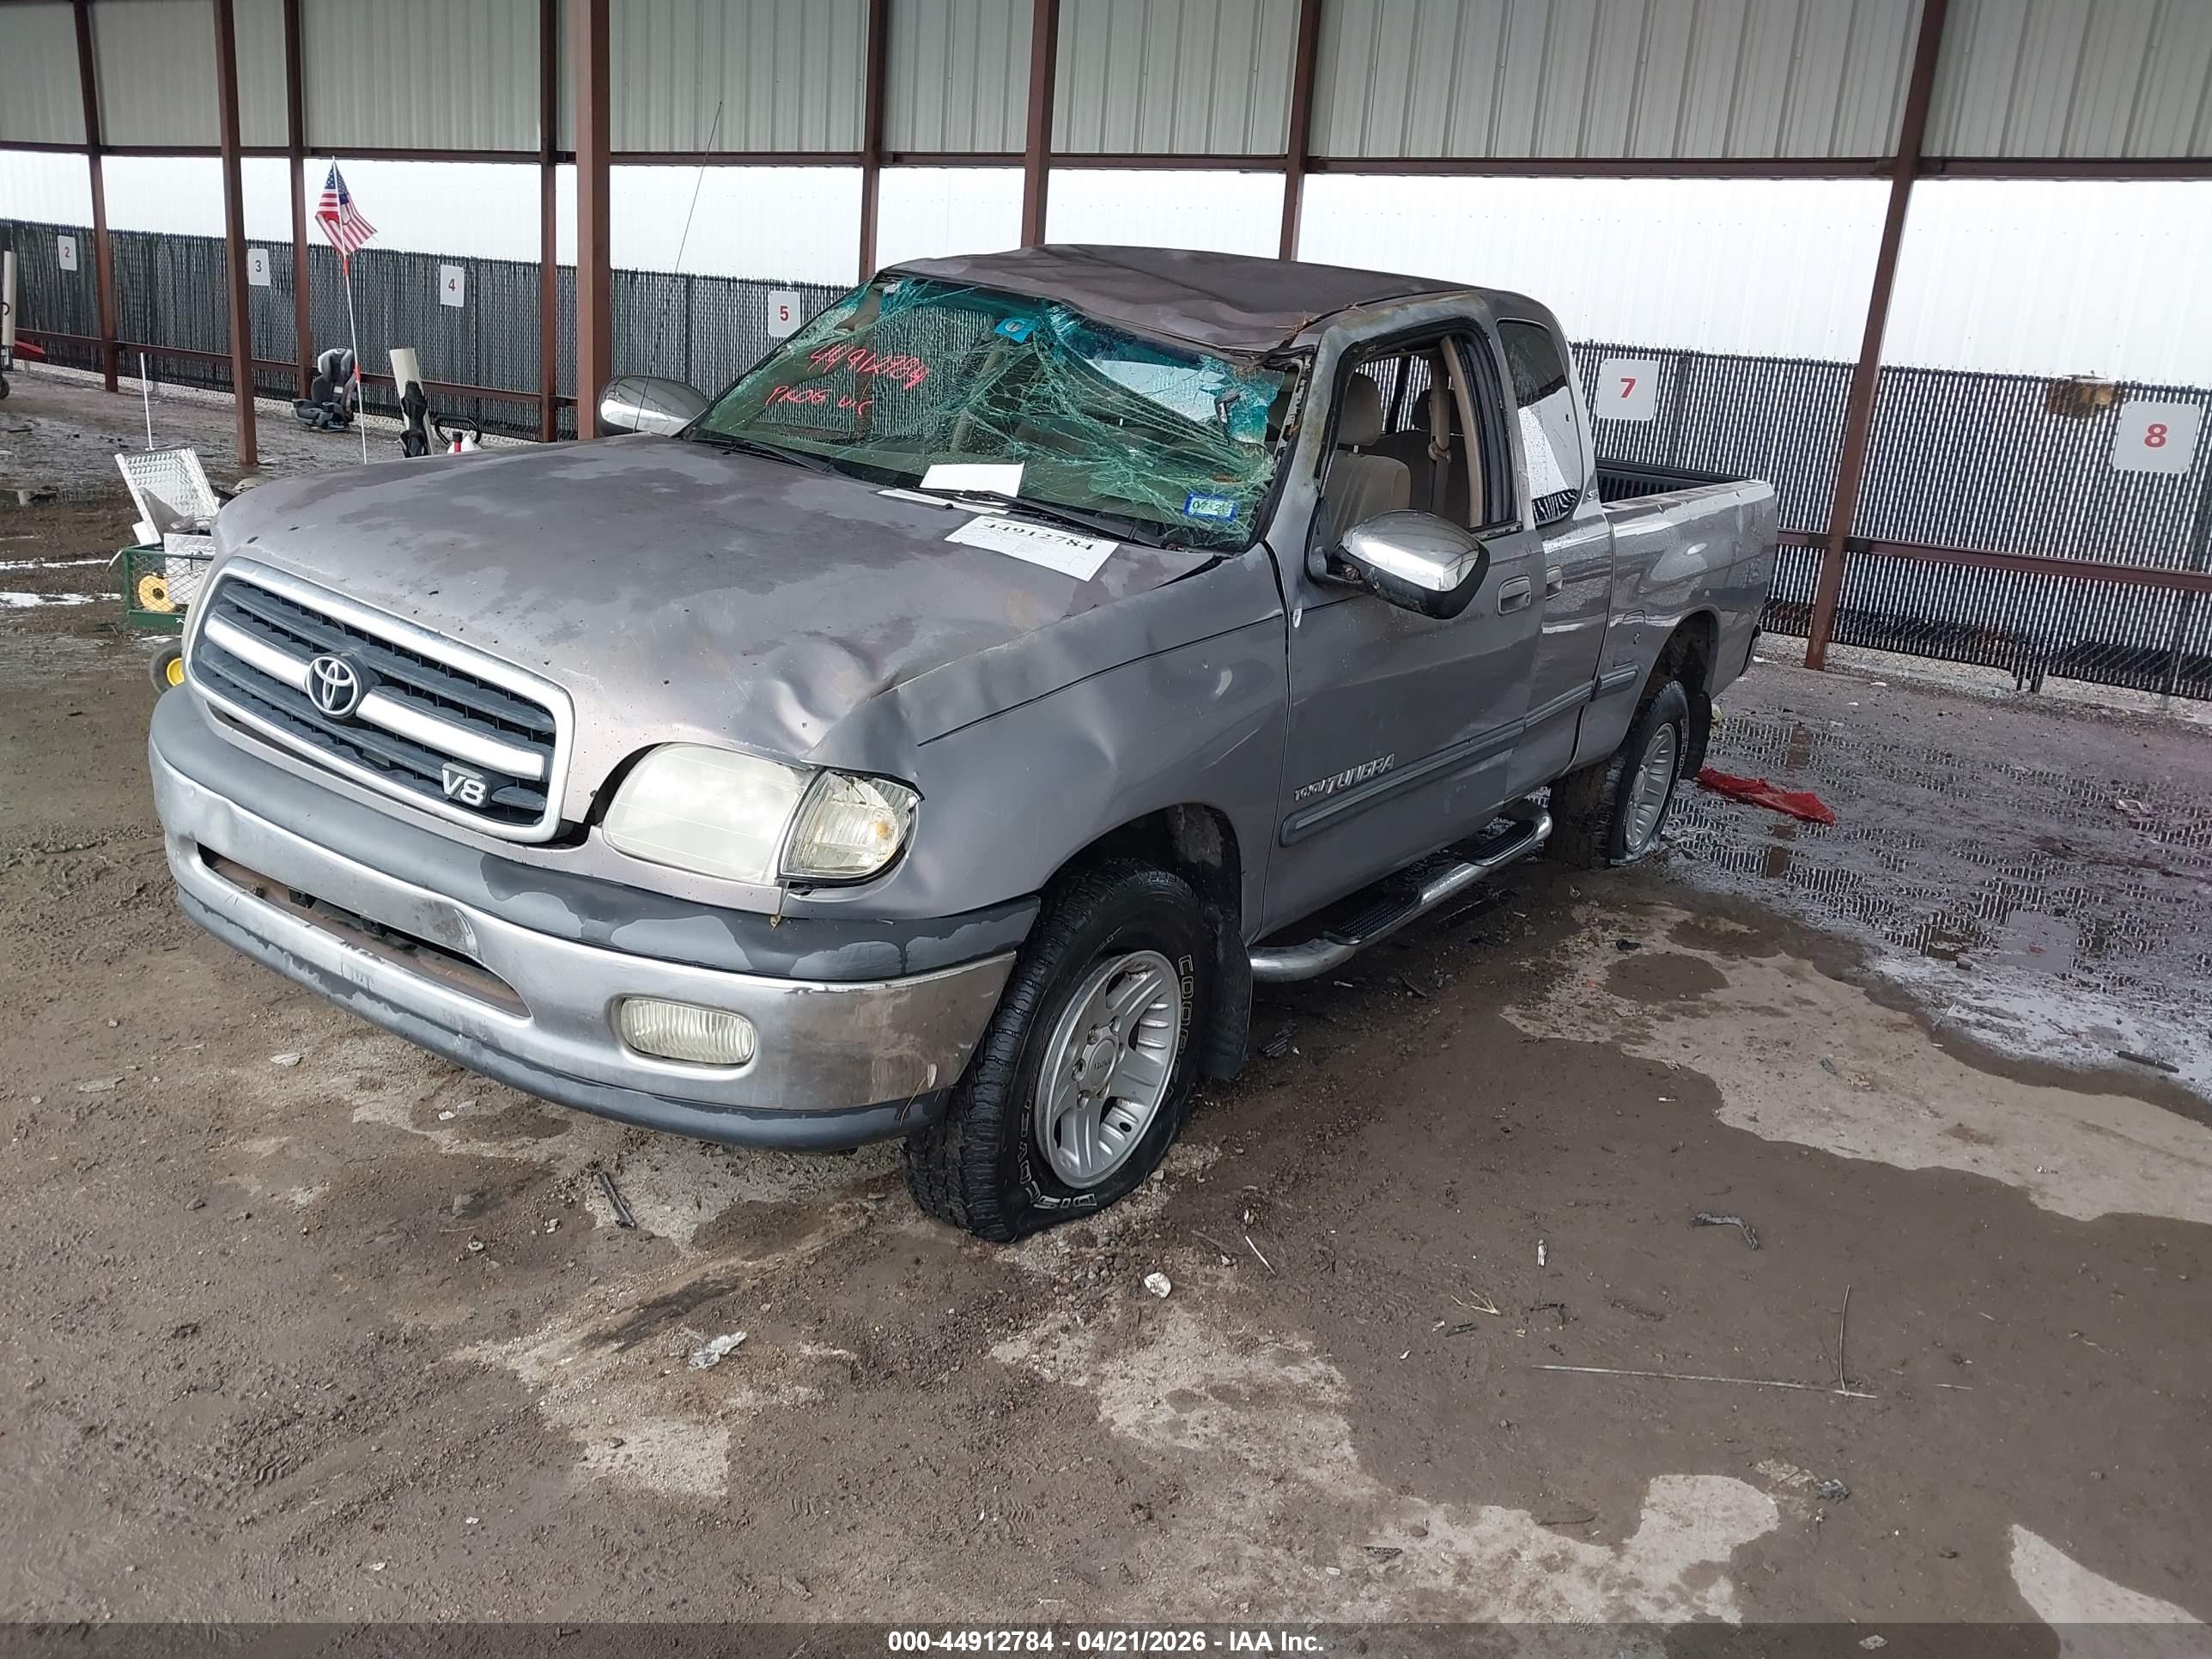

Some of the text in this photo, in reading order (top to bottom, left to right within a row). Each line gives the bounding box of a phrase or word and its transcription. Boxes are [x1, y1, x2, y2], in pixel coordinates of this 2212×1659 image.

[64, 246, 70, 258] 2
[255, 260, 262, 272] 3
[447, 279, 456, 292] 4
[780, 306, 789, 321] 5
[1620, 378, 1637, 398] 7
[2143, 423, 2168, 448] 8
[983, 524, 1094, 550] 44912784
[1326, 753, 1395, 795] TUNDRA
[441, 769, 486, 806] V8
